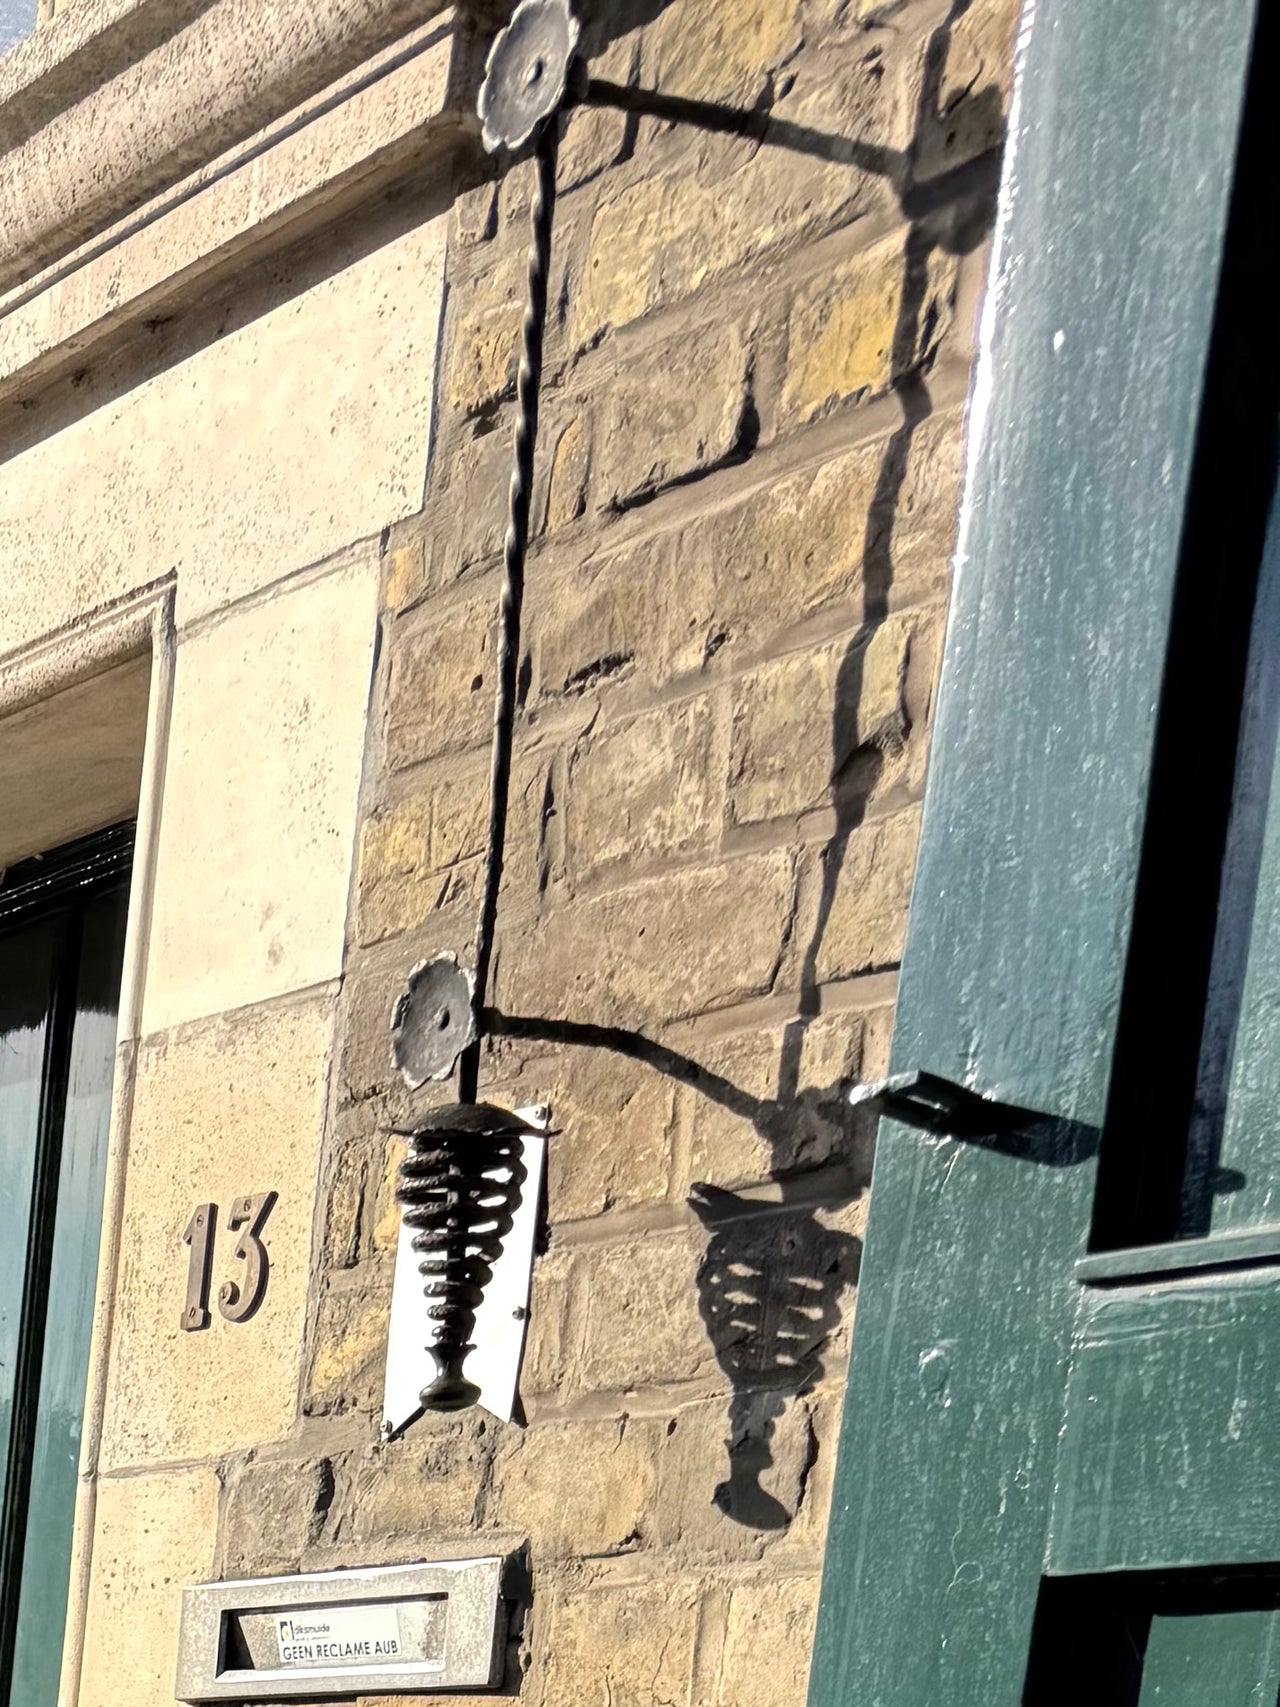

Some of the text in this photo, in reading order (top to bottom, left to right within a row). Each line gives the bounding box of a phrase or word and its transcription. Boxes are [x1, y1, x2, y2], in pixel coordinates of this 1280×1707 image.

[180, 1190, 279, 1332] 13
[283, 1640, 399, 1661] GEEN RECLAME AUB
